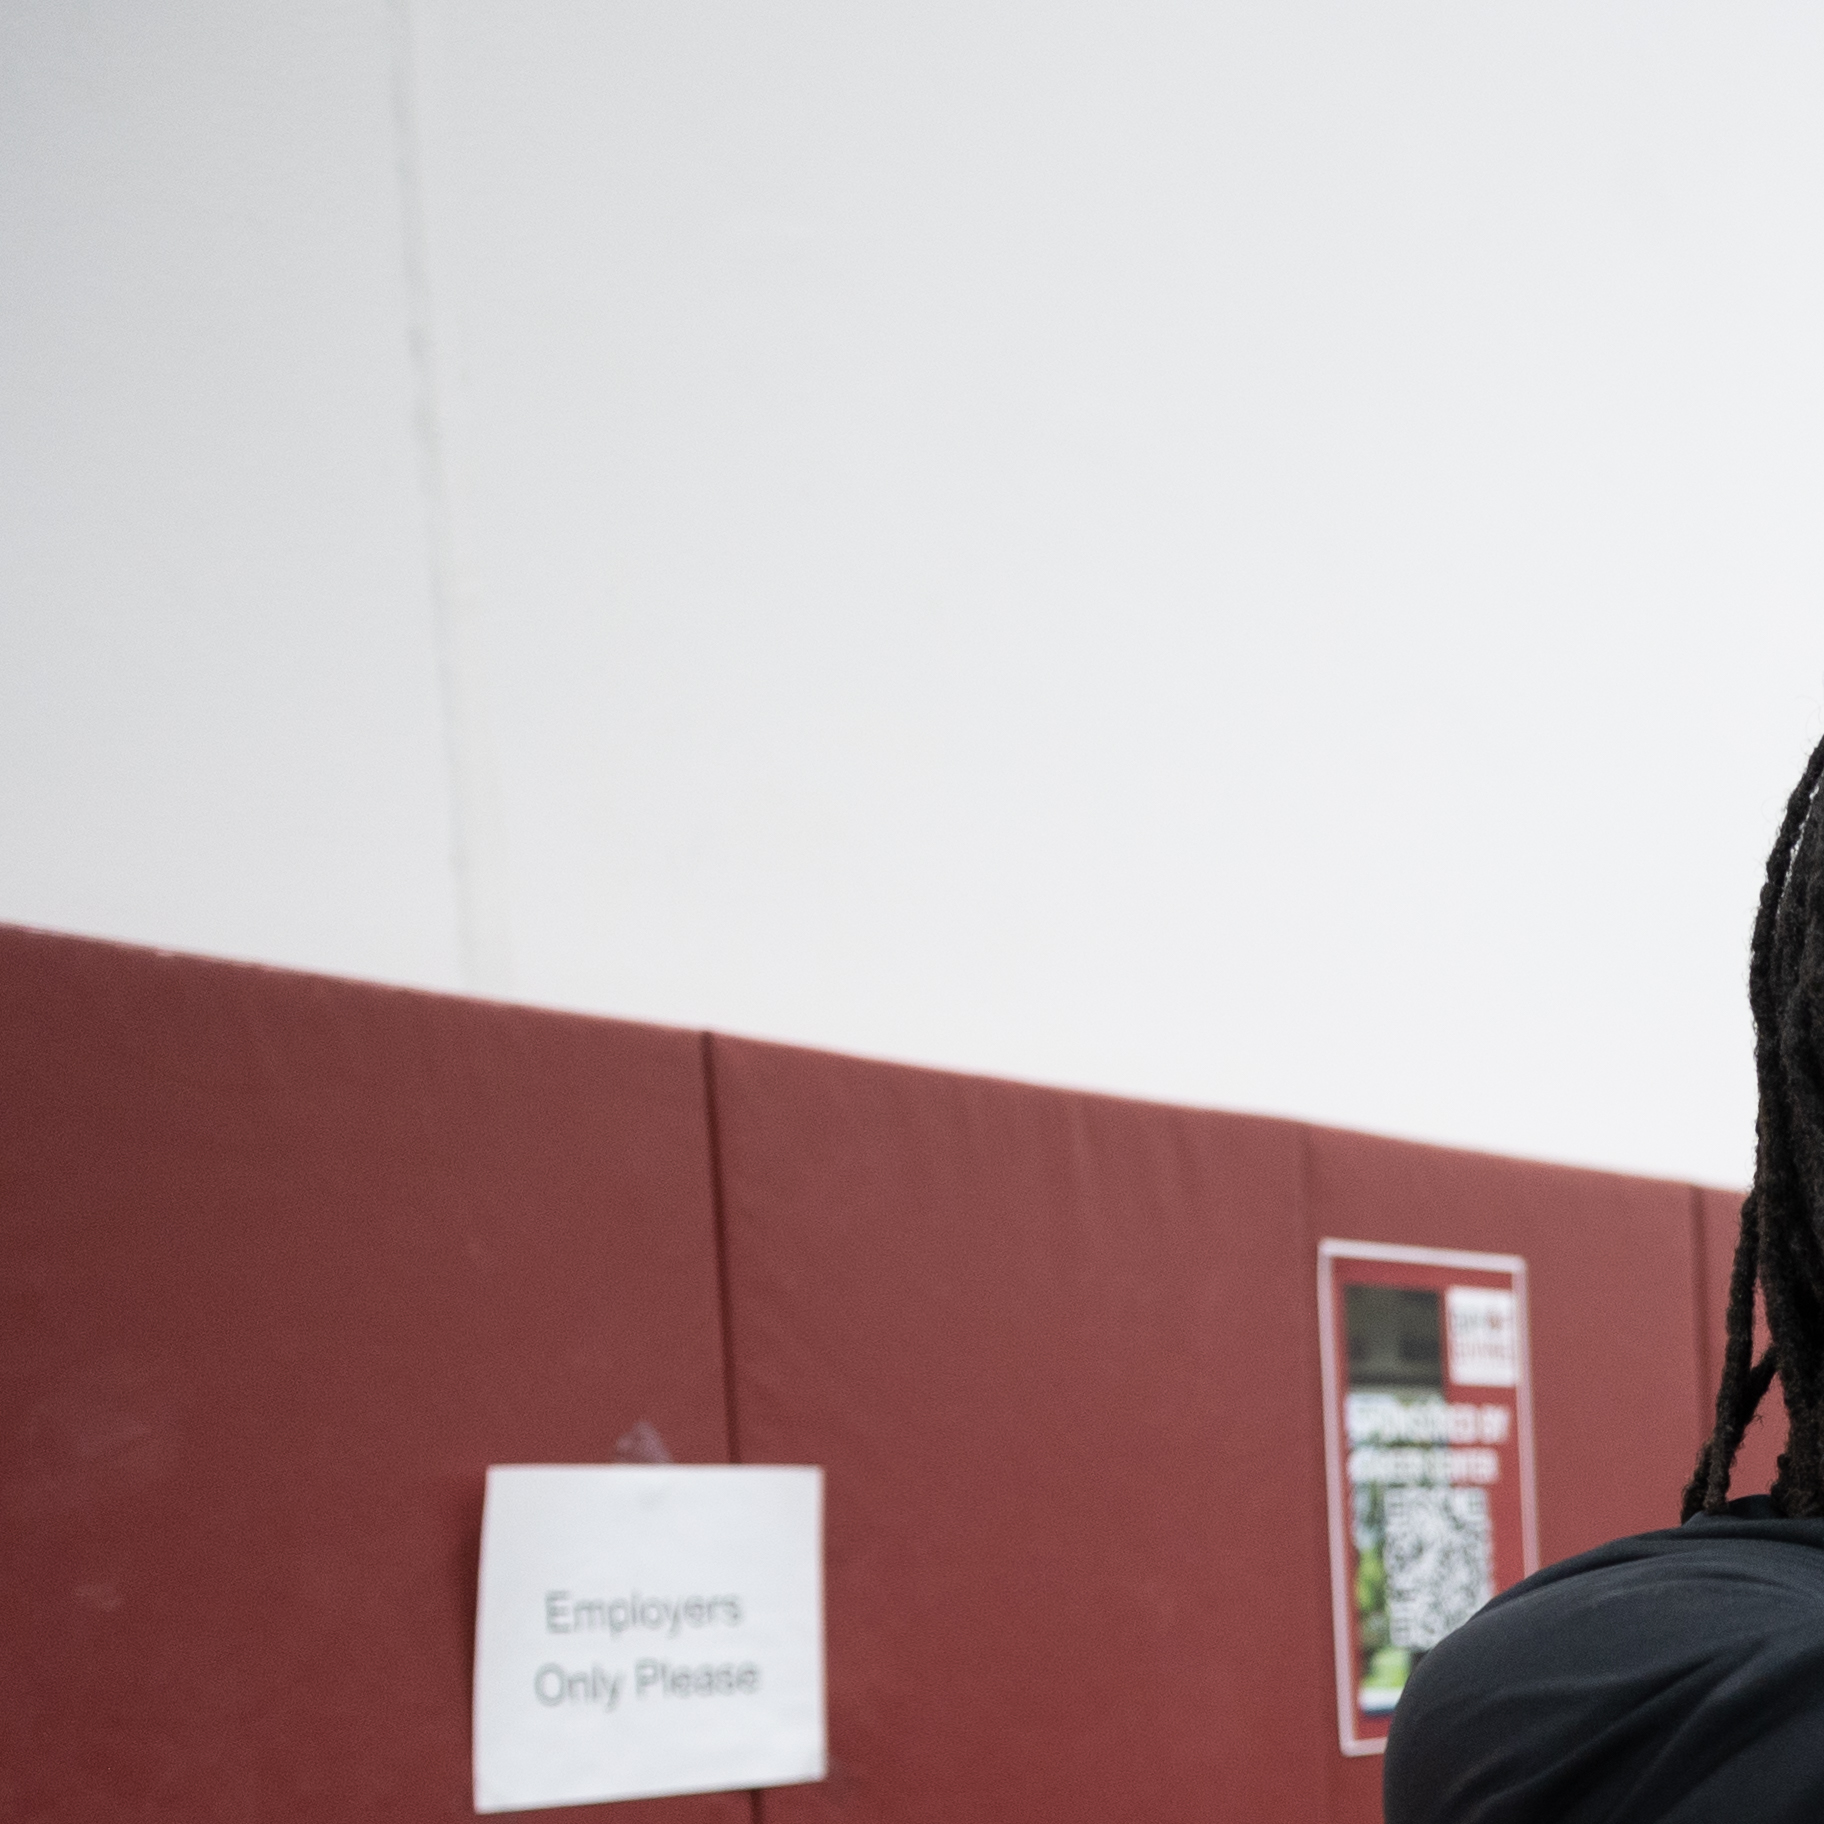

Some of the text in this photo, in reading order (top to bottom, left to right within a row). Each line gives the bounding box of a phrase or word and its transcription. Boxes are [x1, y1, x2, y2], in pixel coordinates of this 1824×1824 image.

[545, 1590, 744, 1640] Employers
[534, 1658, 763, 1714] Only Please
